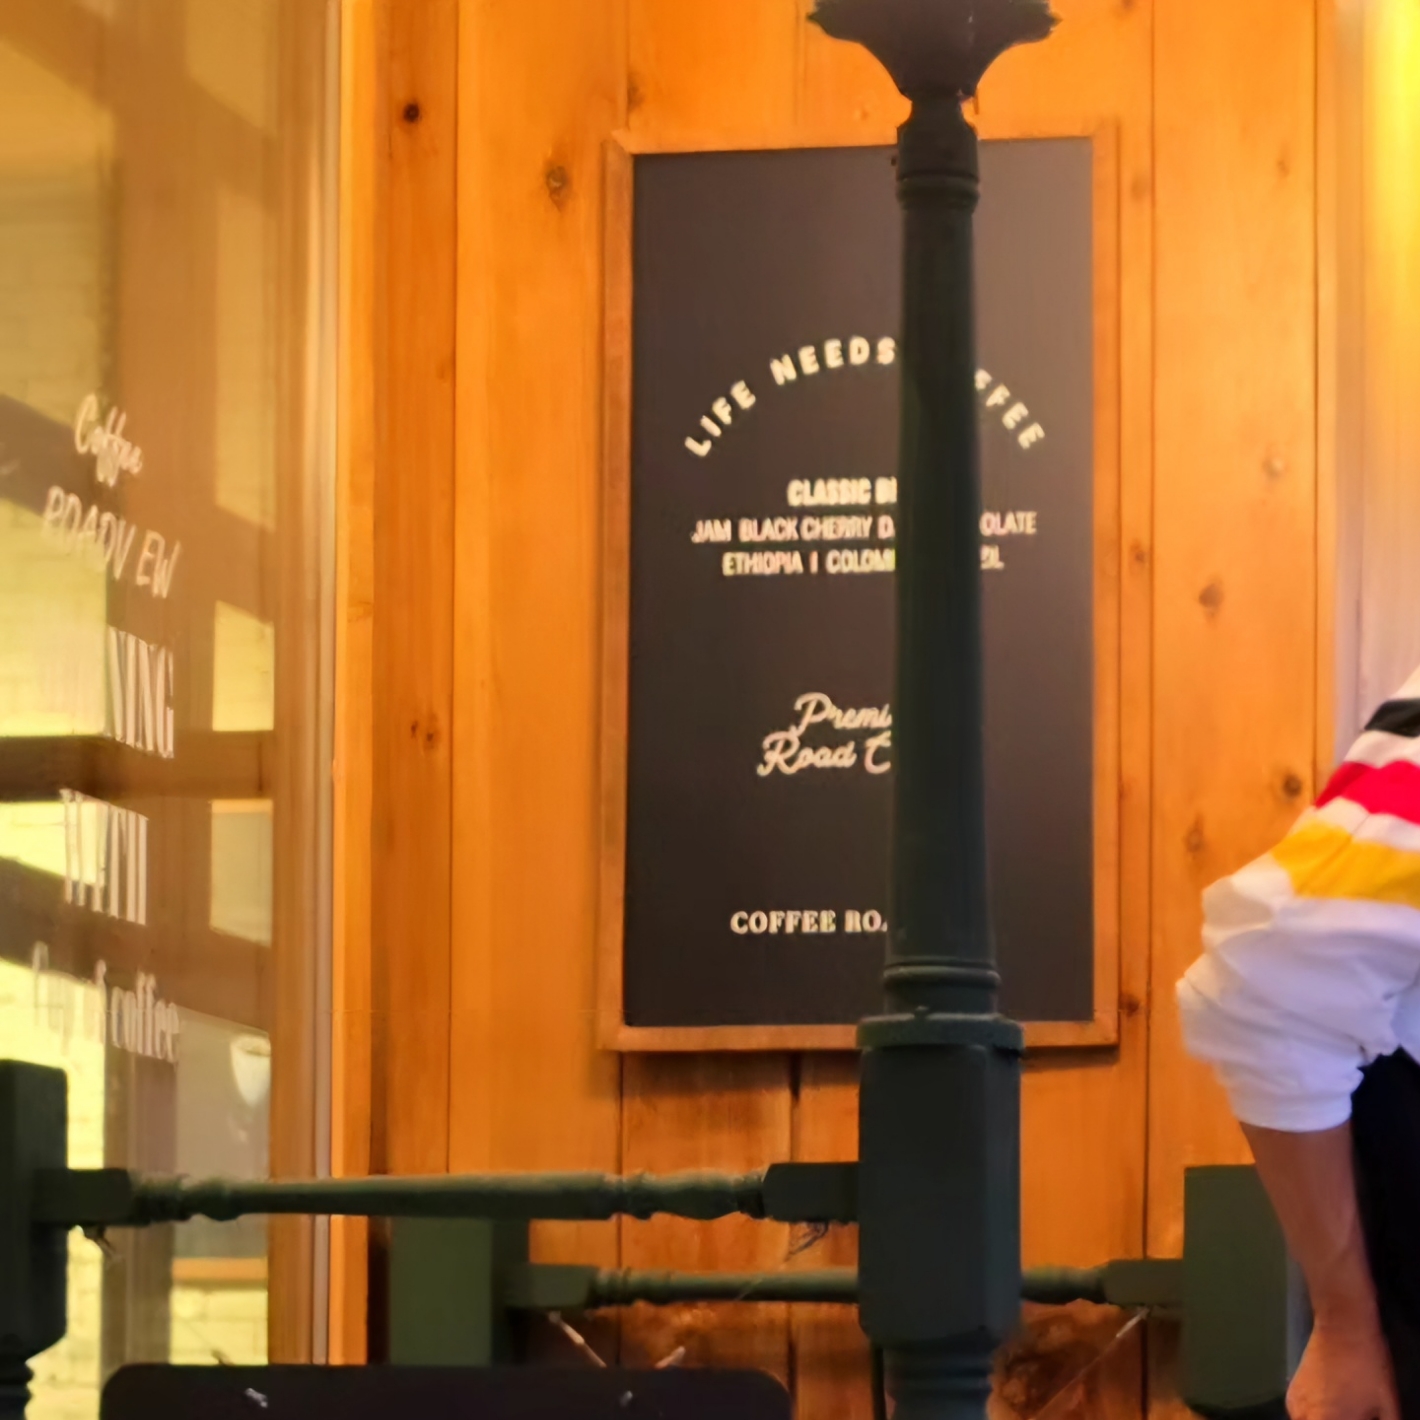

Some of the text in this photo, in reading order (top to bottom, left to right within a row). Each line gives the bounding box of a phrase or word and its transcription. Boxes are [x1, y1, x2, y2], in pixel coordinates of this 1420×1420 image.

[684, 336, 1046, 457] LIFE NEEDS FFEE
[786, 477, 872, 507] CLASSIC
[690, 519, 732, 544] JAM
[738, 516, 799, 543] BLACK
[800, 514, 873, 541] CHERRY
[978, 510, 1038, 537] OLATE
[722, 550, 804, 576] ETHIOPIA
[790, 691, 893, 736] Premi
[756, 730, 893, 777] Road C
[729, 908, 888, 935] COFFEE RO
